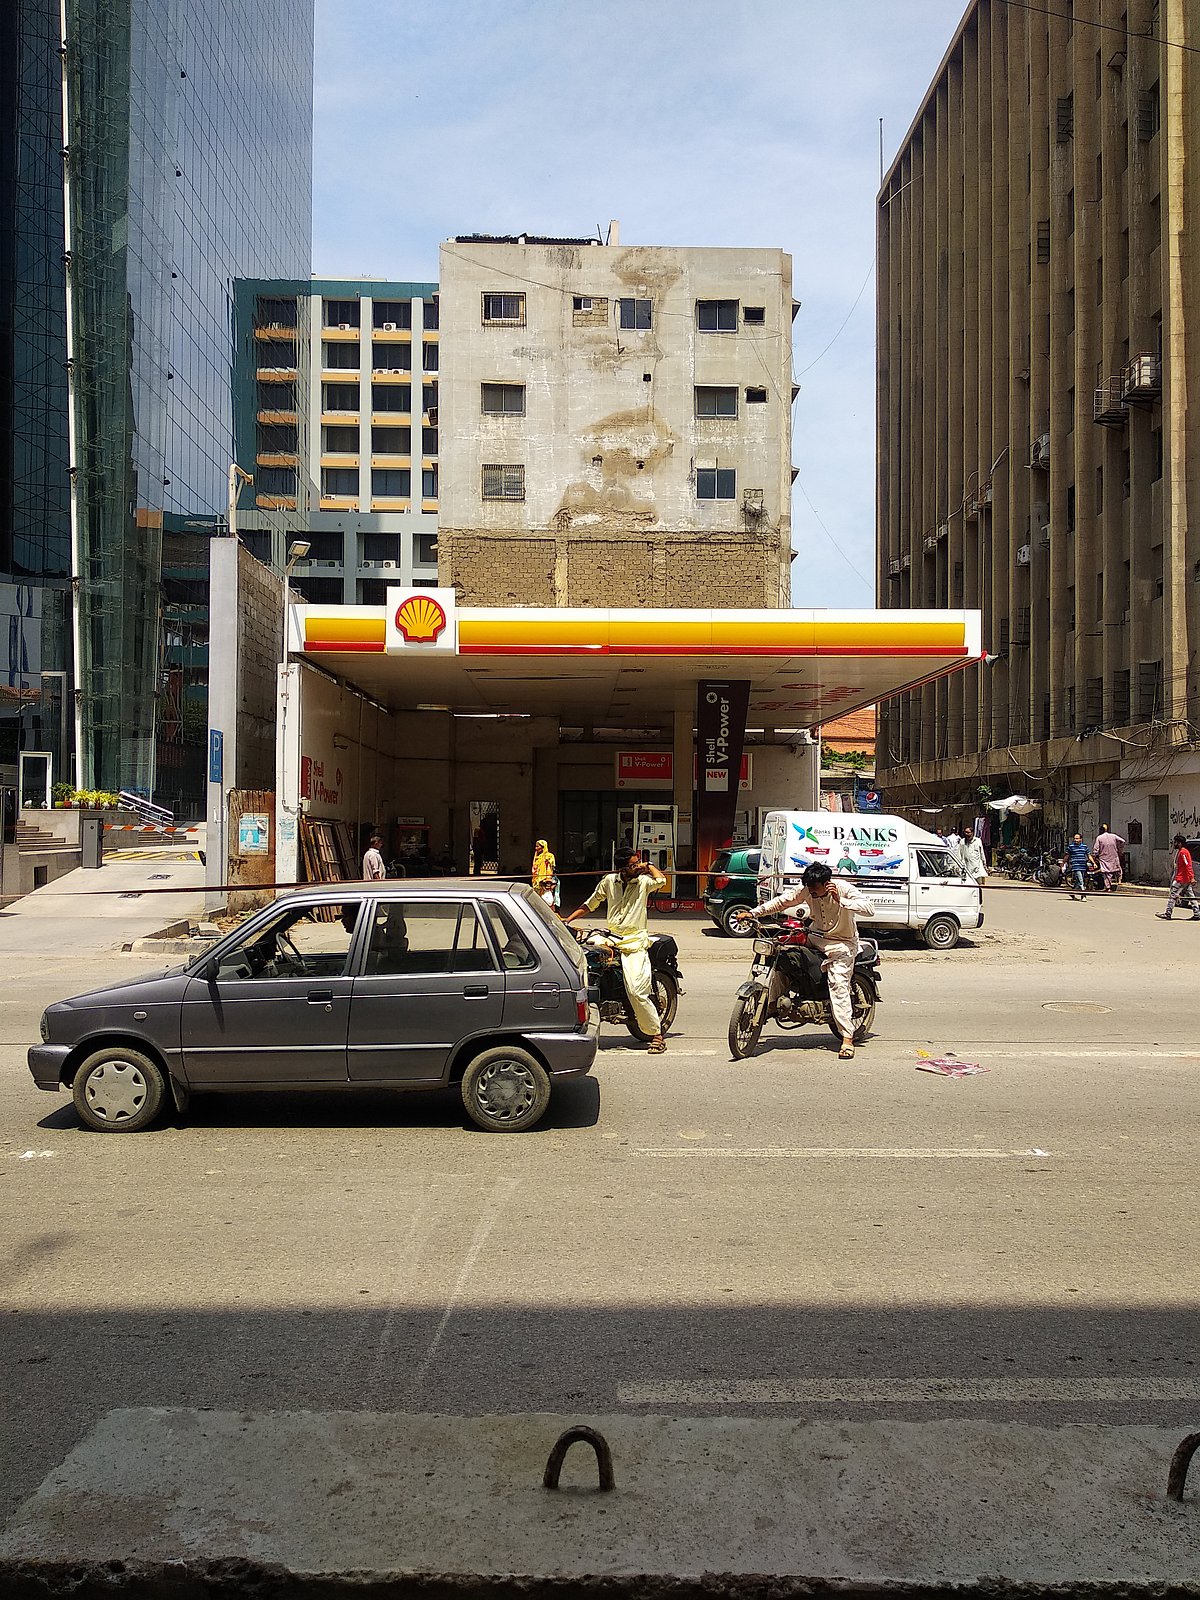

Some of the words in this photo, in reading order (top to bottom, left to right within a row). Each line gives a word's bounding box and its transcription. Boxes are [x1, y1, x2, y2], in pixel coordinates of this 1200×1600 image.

[716, 697, 730, 764] V-Power
[213, 734, 220, 762] P
[706, 738, 716, 763] Shell
[833, 826, 898, 842] BANKS
